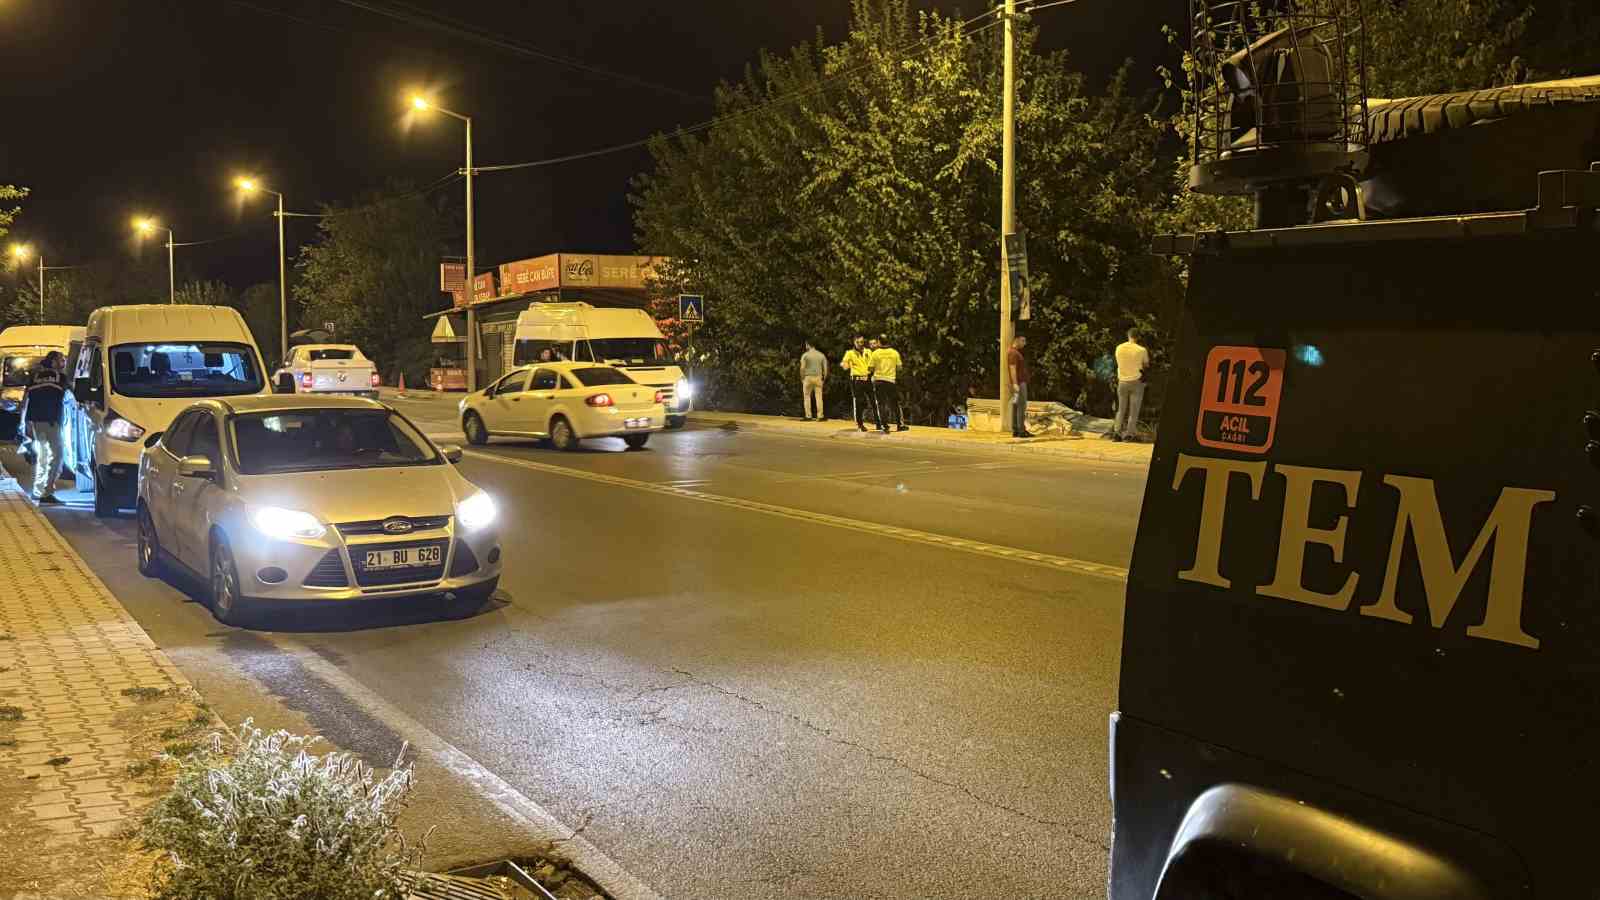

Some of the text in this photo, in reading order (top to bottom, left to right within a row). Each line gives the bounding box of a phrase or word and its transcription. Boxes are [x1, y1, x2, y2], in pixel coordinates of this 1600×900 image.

[1217, 359, 1270, 406] 112
[368, 547, 440, 566] 21 BU 628
[1172, 453, 1556, 649] TEM
